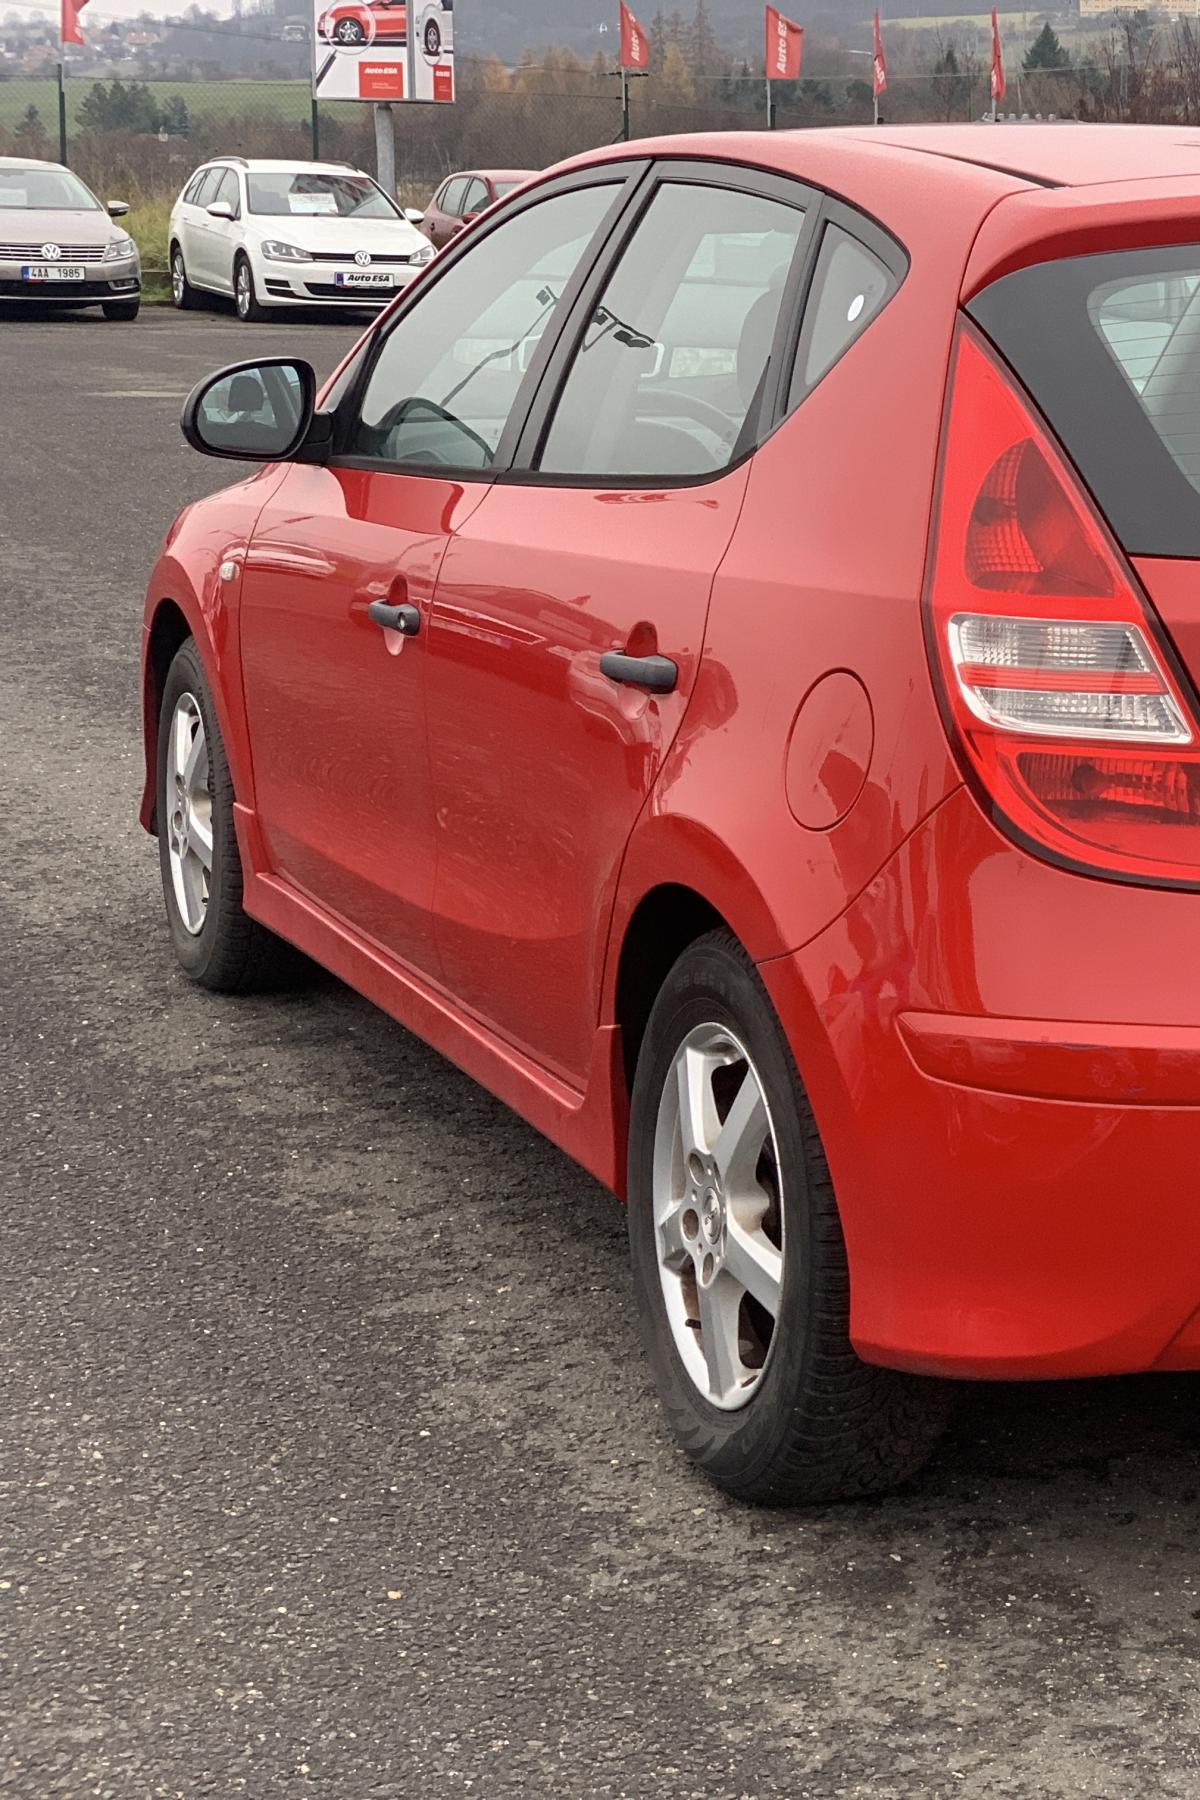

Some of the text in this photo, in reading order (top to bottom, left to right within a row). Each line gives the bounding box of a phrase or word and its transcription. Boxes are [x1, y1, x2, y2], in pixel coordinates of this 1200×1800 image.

[777, 38, 787, 74] Auto
[364, 67, 398, 75] Auto ESA
[31, 268, 81, 278] 4AA 1985
[347, 274, 390, 282] Auto ESA
